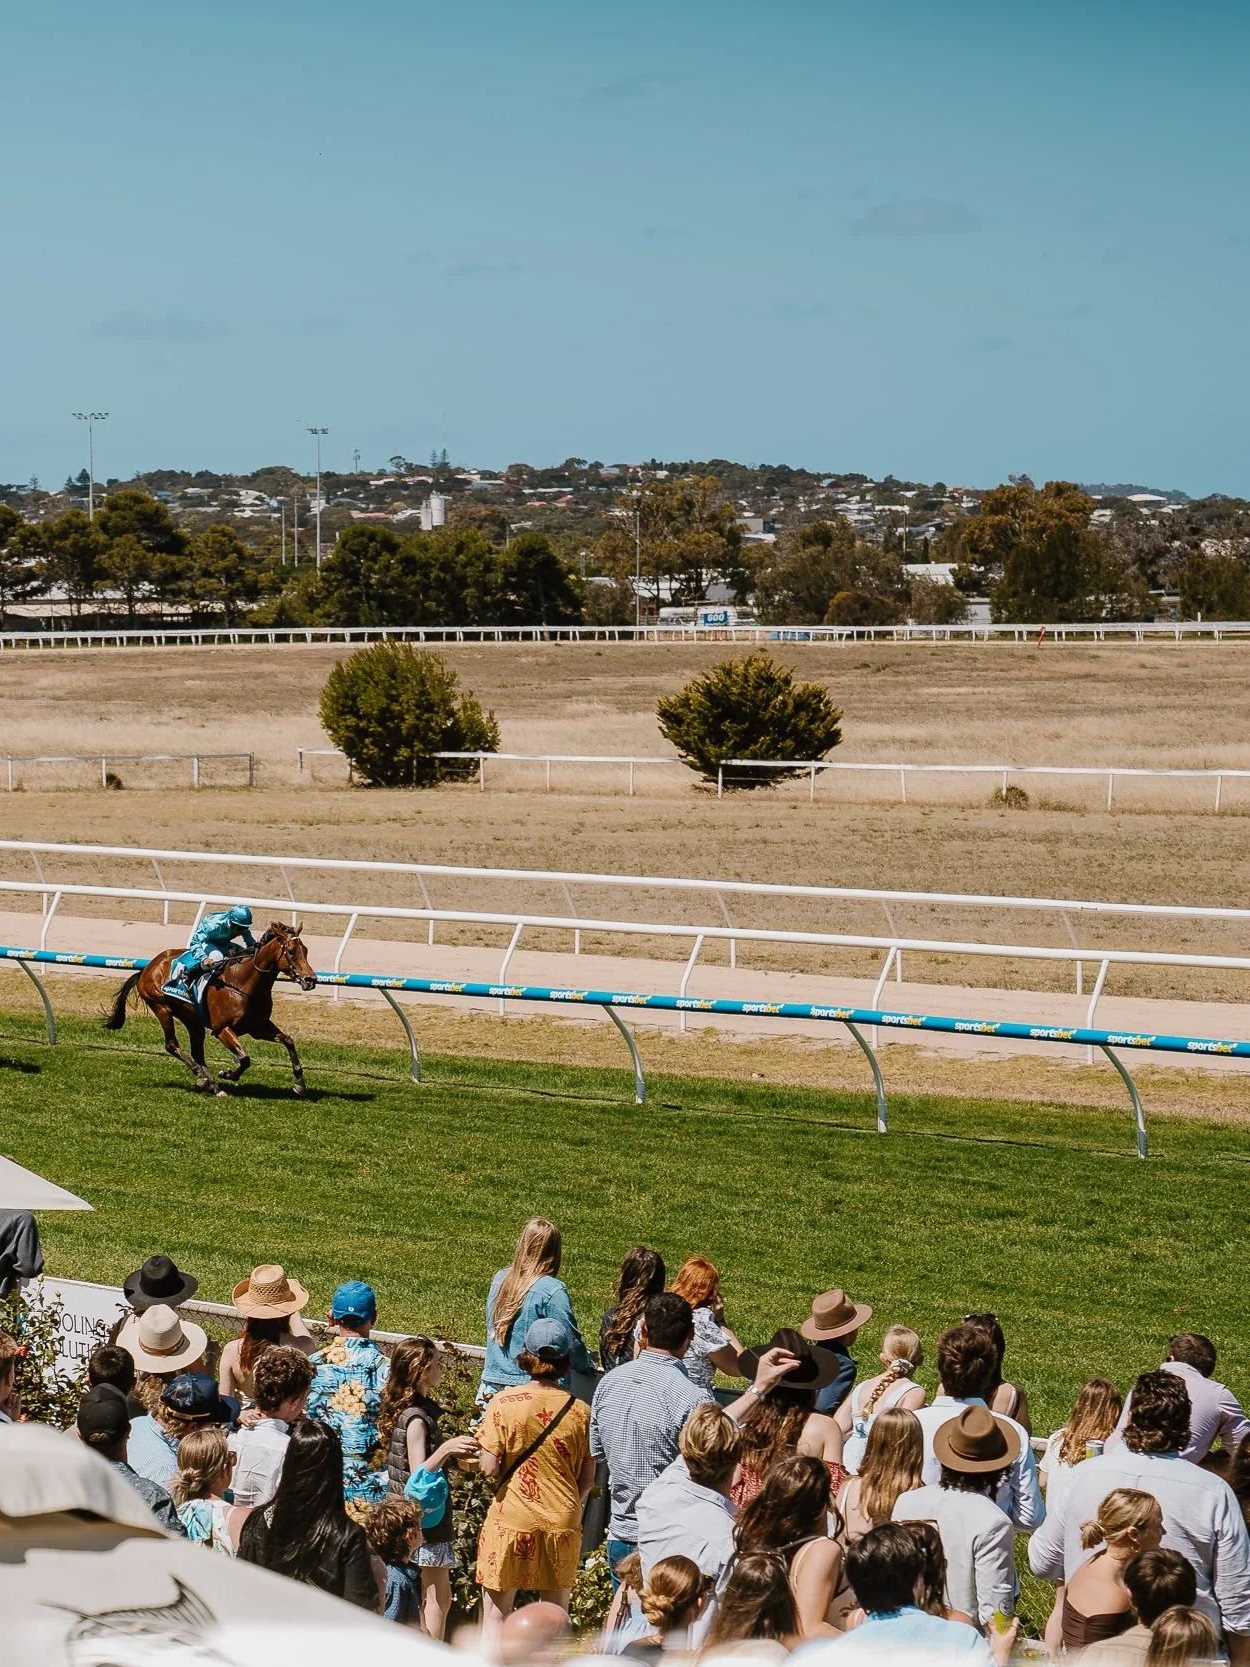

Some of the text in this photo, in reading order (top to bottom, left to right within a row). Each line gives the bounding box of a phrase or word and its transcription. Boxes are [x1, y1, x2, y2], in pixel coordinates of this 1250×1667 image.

[429, 982, 463, 993] sportsbet
[488, 986, 523, 996] sportsbet
[549, 990, 585, 1001] sportsbet
[611, 994, 648, 1005] sportsbet
[676, 999, 713, 1009] sportsbet
[742, 1003, 781, 1014] sportsbet
[810, 1006, 851, 1019] sportsbet
[881, 1014, 923, 1026] sportsbet
[954, 1021, 997, 1033] sportsbet
[1030, 1028, 1073, 1040] sportsbet
[1107, 1034, 1152, 1046] sportsbet
[1187, 1041, 1234, 1054] sportsbet
